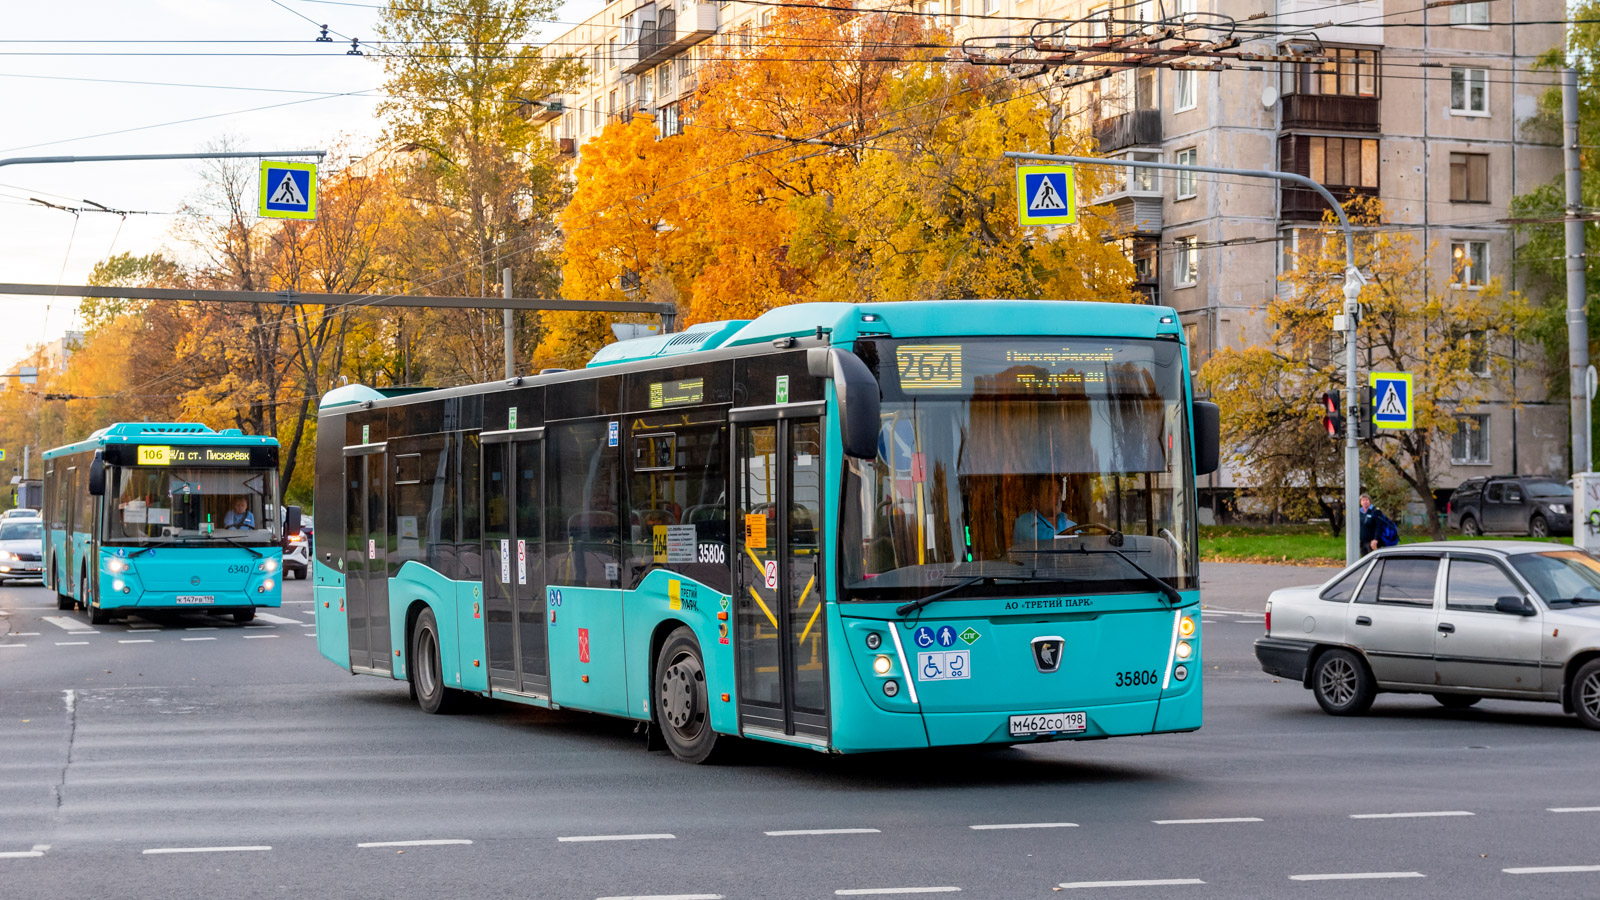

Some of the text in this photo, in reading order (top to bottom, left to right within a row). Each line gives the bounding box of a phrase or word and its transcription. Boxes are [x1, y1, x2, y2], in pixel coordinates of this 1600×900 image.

[897, 353, 954, 381] 264
[143, 449, 163, 460] 106
[698, 543, 725, 564] 35806
[227, 565, 250, 574] 6340
[1005, 601, 1019, 610] АО
[1115, 669, 1158, 688] 35806
[1065, 713, 1083, 725] 198
